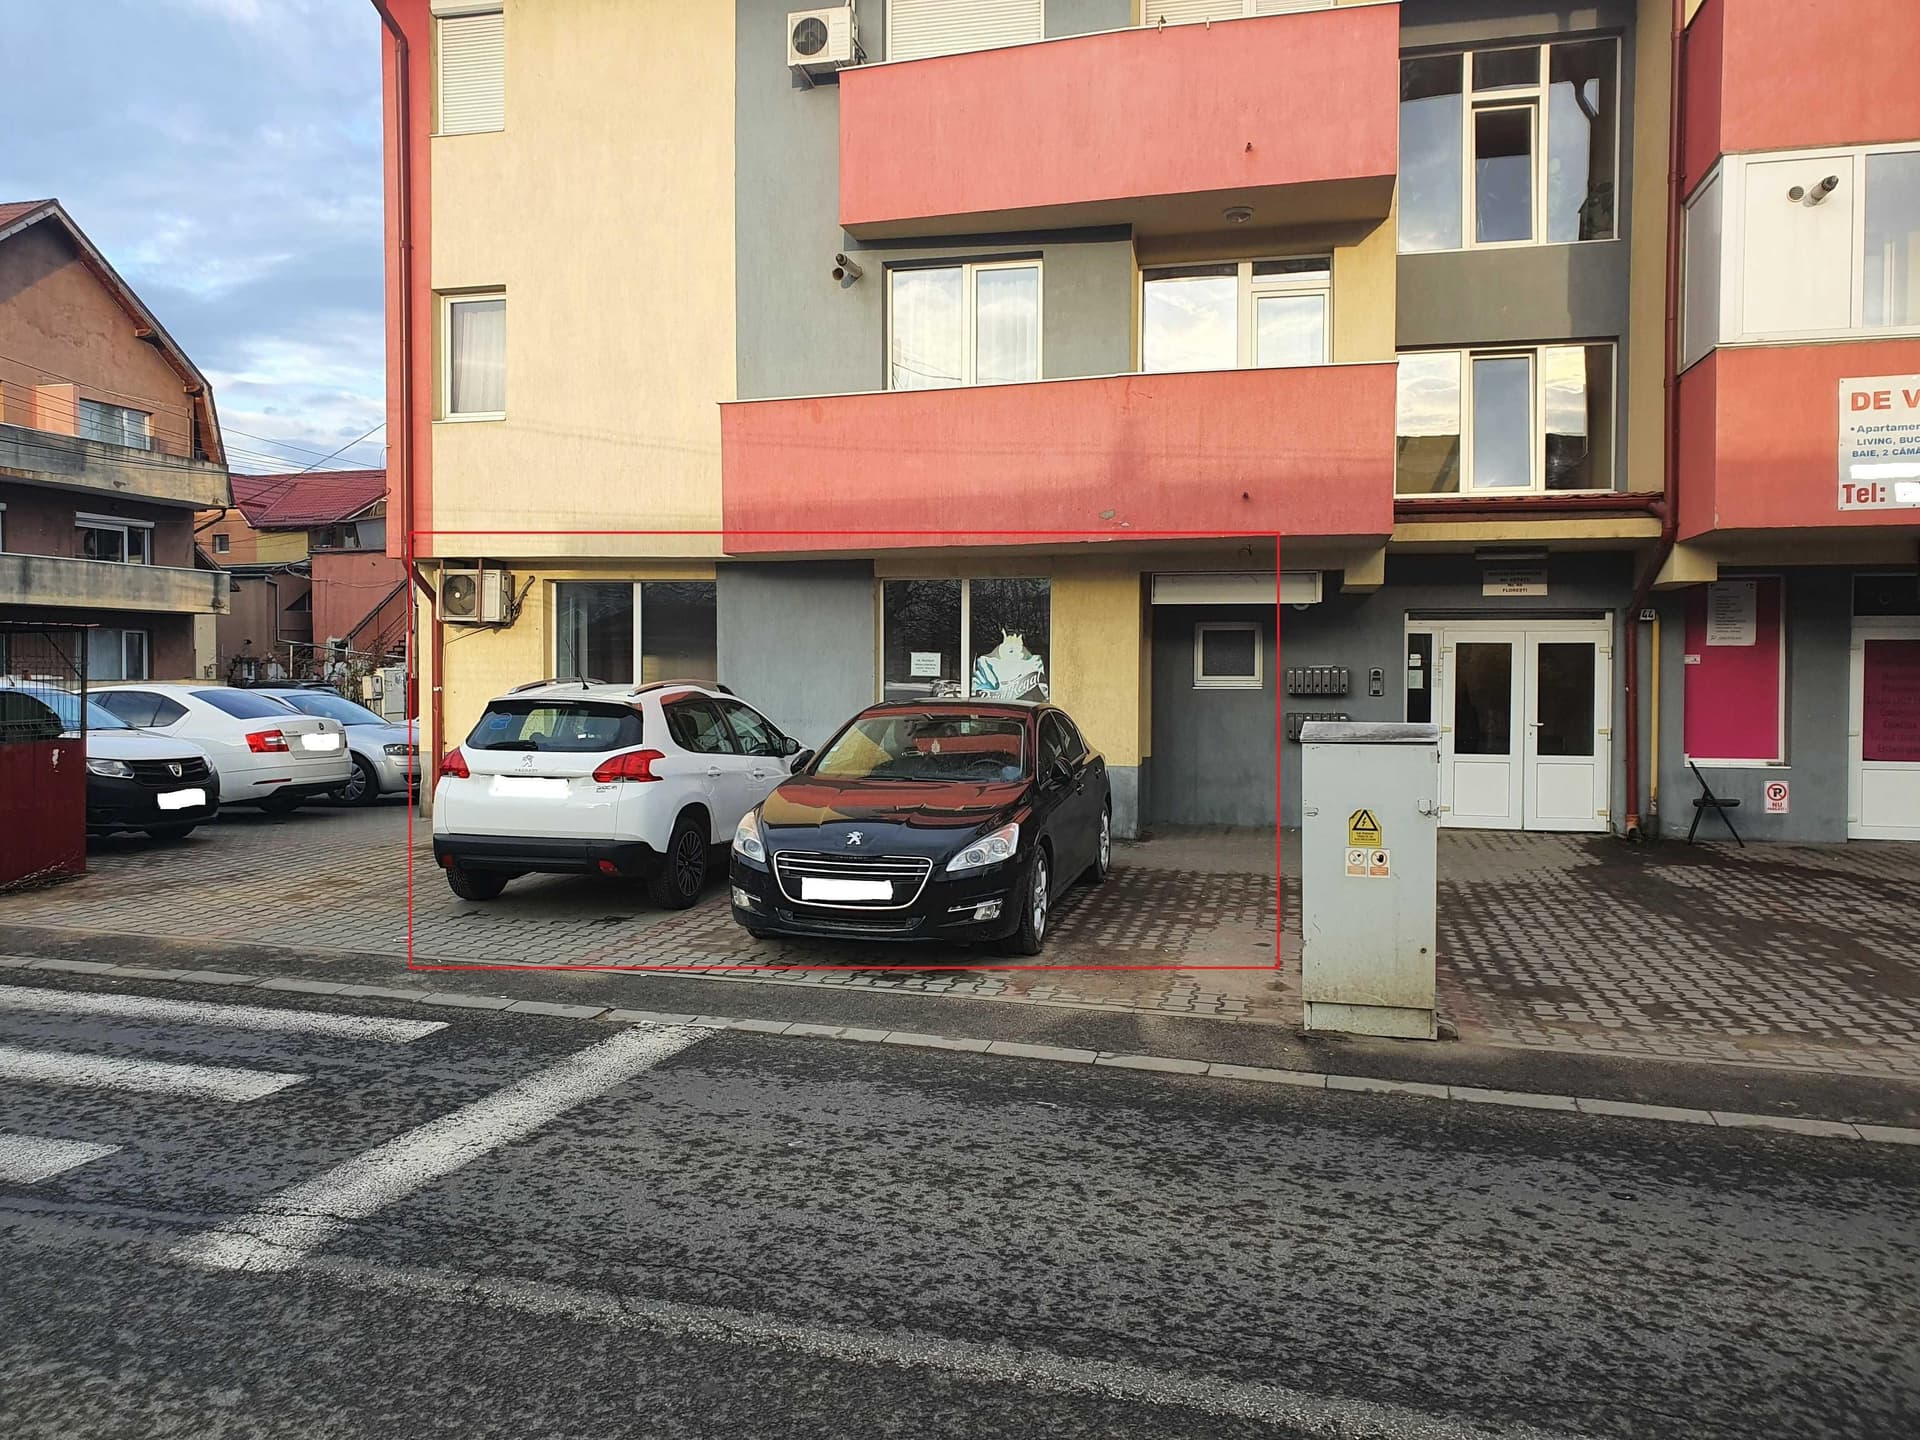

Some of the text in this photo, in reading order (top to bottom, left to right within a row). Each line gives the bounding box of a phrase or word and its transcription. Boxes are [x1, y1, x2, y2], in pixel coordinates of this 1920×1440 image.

[1851, 390, 1891, 411] DE
[1857, 437, 1896, 446] LIVING,
[1852, 449, 1880, 458] BAIE,
[1882, 449, 1889, 457] 2
[1842, 483, 1886, 504] Tel:
